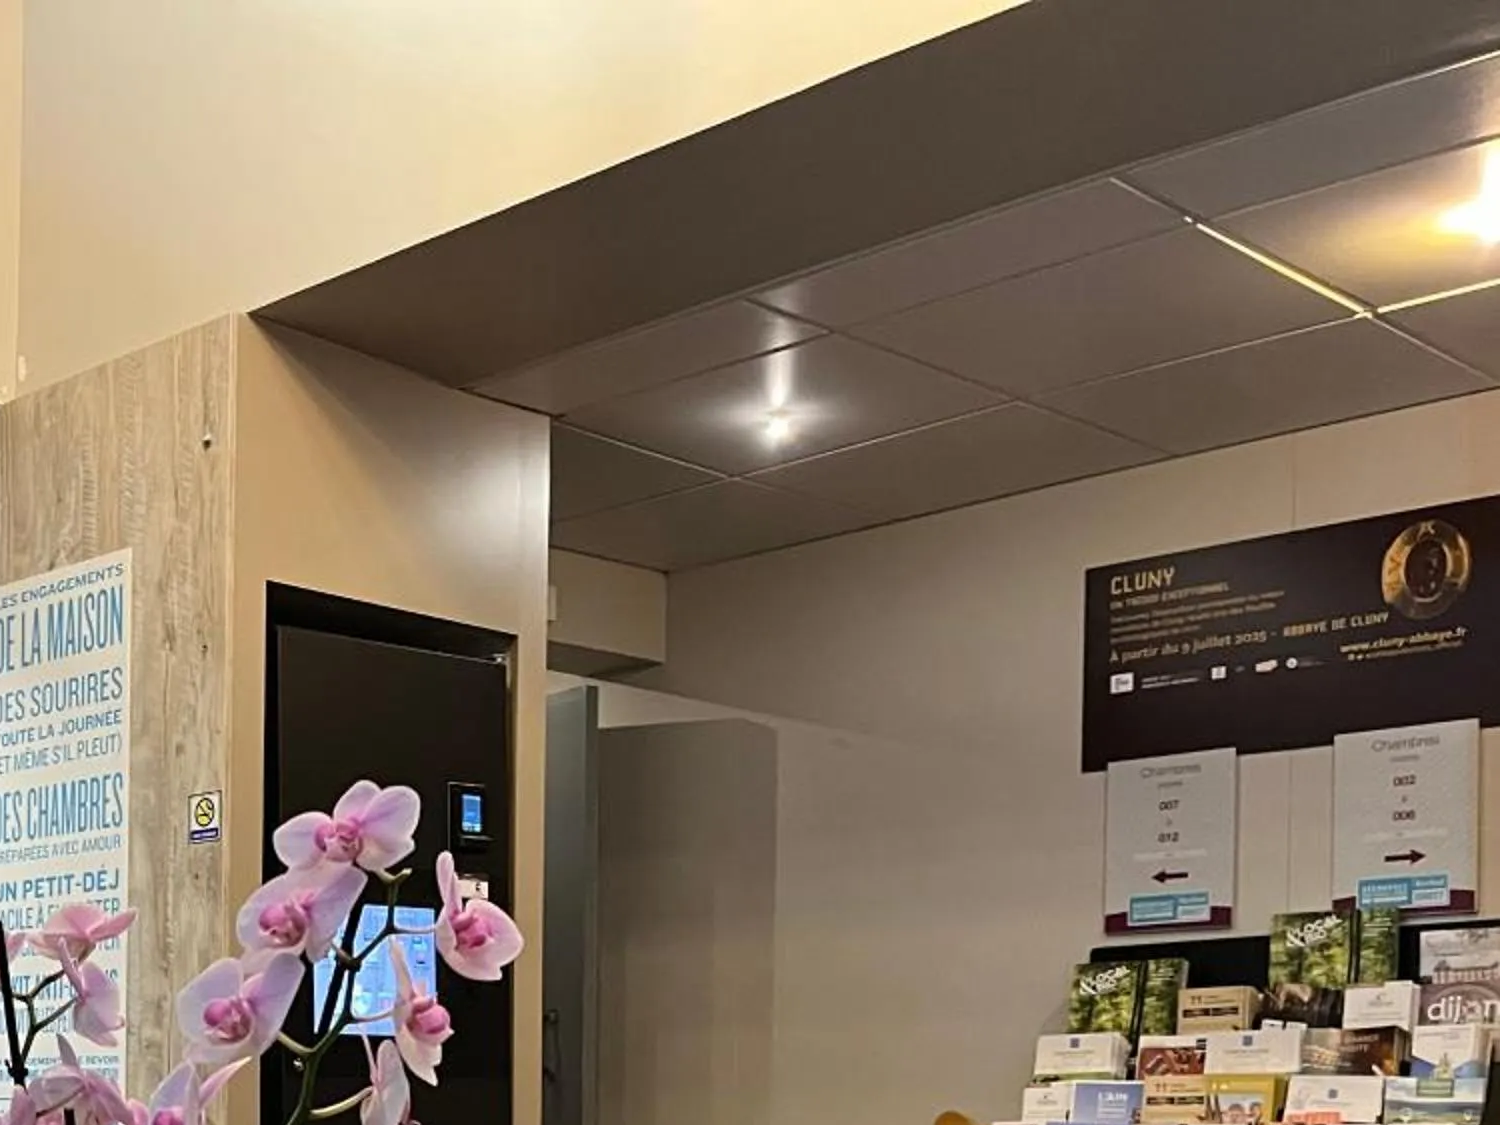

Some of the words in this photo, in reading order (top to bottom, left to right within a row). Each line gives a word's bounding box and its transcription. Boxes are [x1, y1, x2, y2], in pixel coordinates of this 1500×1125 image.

[21, 563, 124, 603] ENGAGEMENTS
[1110, 566, 1176, 595] CLUNY
[21, 607, 42, 667] LA
[47, 583, 123, 662] MAISON
[1182, 642, 1191, 655] 9
[1193, 635, 1231, 655] juillet
[1351, 611, 1389, 628] CLUNY
[30, 666, 123, 717] SOURIRES
[38, 724, 55, 741] LA
[77, 732, 122, 759] PLEUT)
[27, 772, 123, 840] CHAMBRES
[51, 841, 79, 858] AVEC
[81, 833, 121, 853] AMOUR
[22, 863, 120, 900] PETIT-DÉJ
